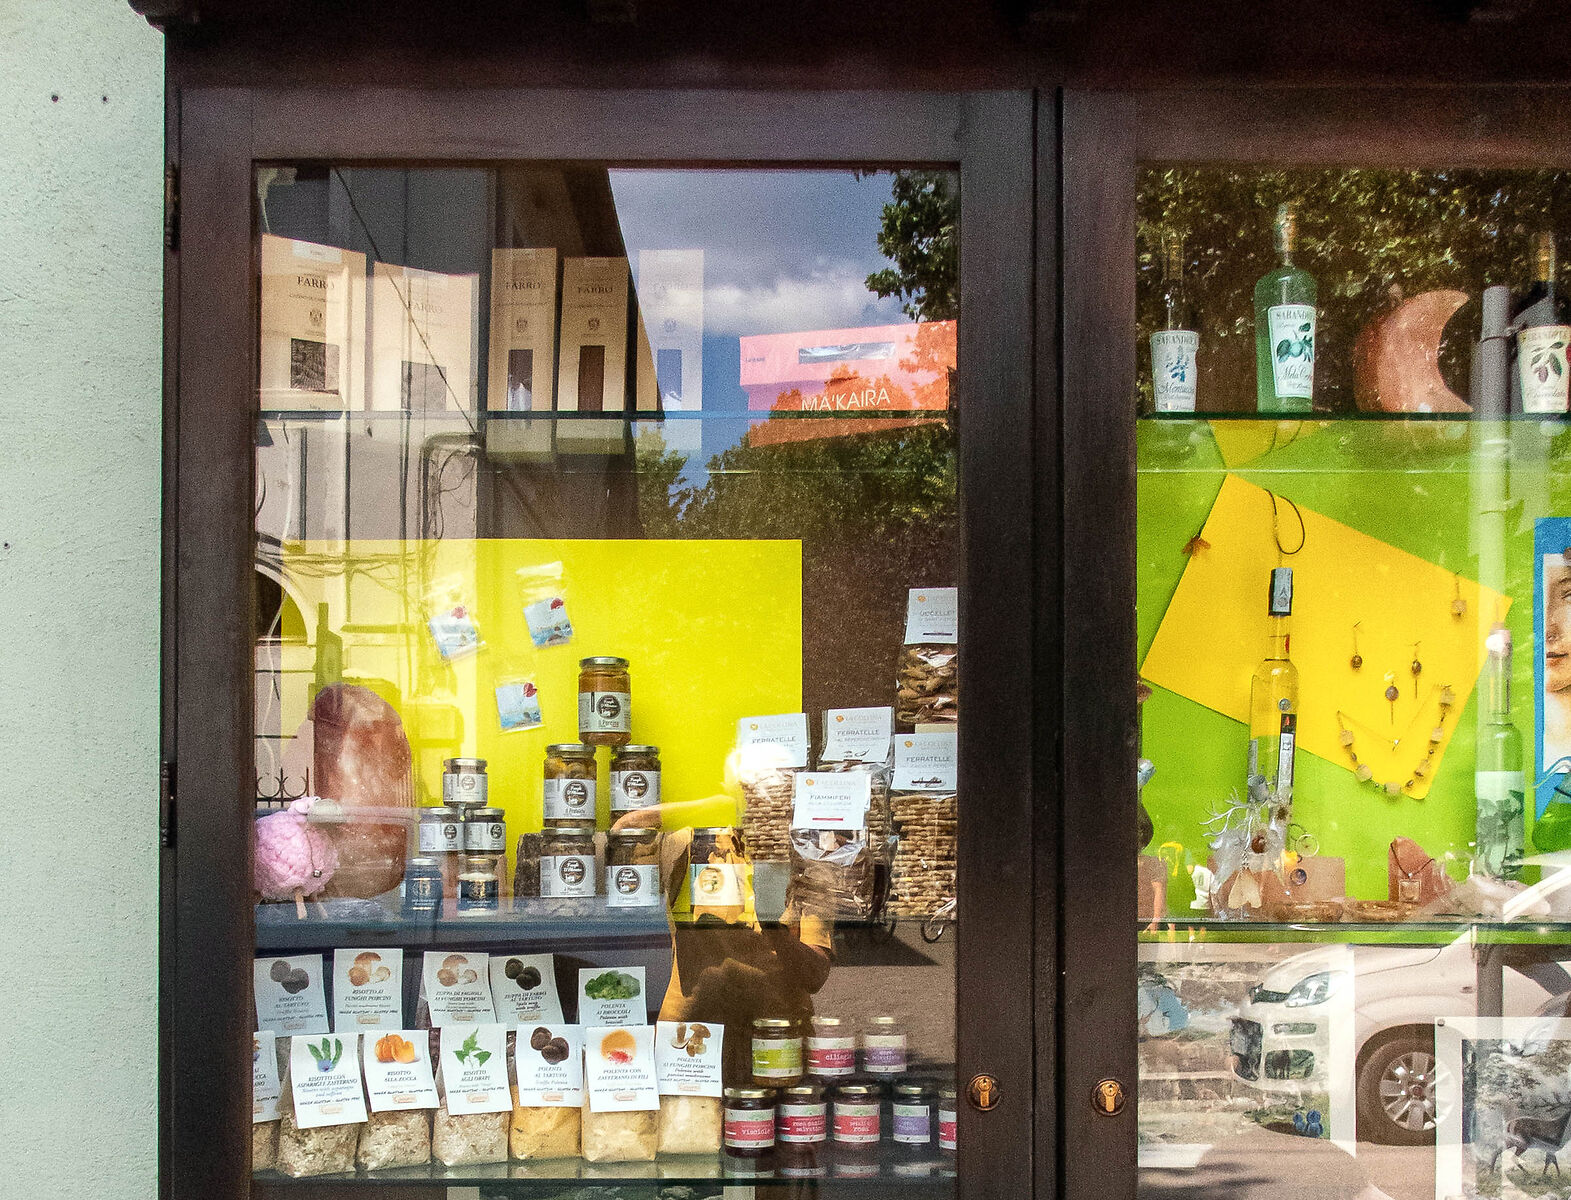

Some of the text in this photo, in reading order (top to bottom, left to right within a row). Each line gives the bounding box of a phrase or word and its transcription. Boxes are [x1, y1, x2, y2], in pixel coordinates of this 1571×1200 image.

[297, 275, 335, 290] FARRO
[505, 281, 542, 290] FARRO
[577, 286, 614, 294] FARRO
[801, 388, 891, 412] MA'KAIRA
[837, 729, 880, 737] FERRATELLE
